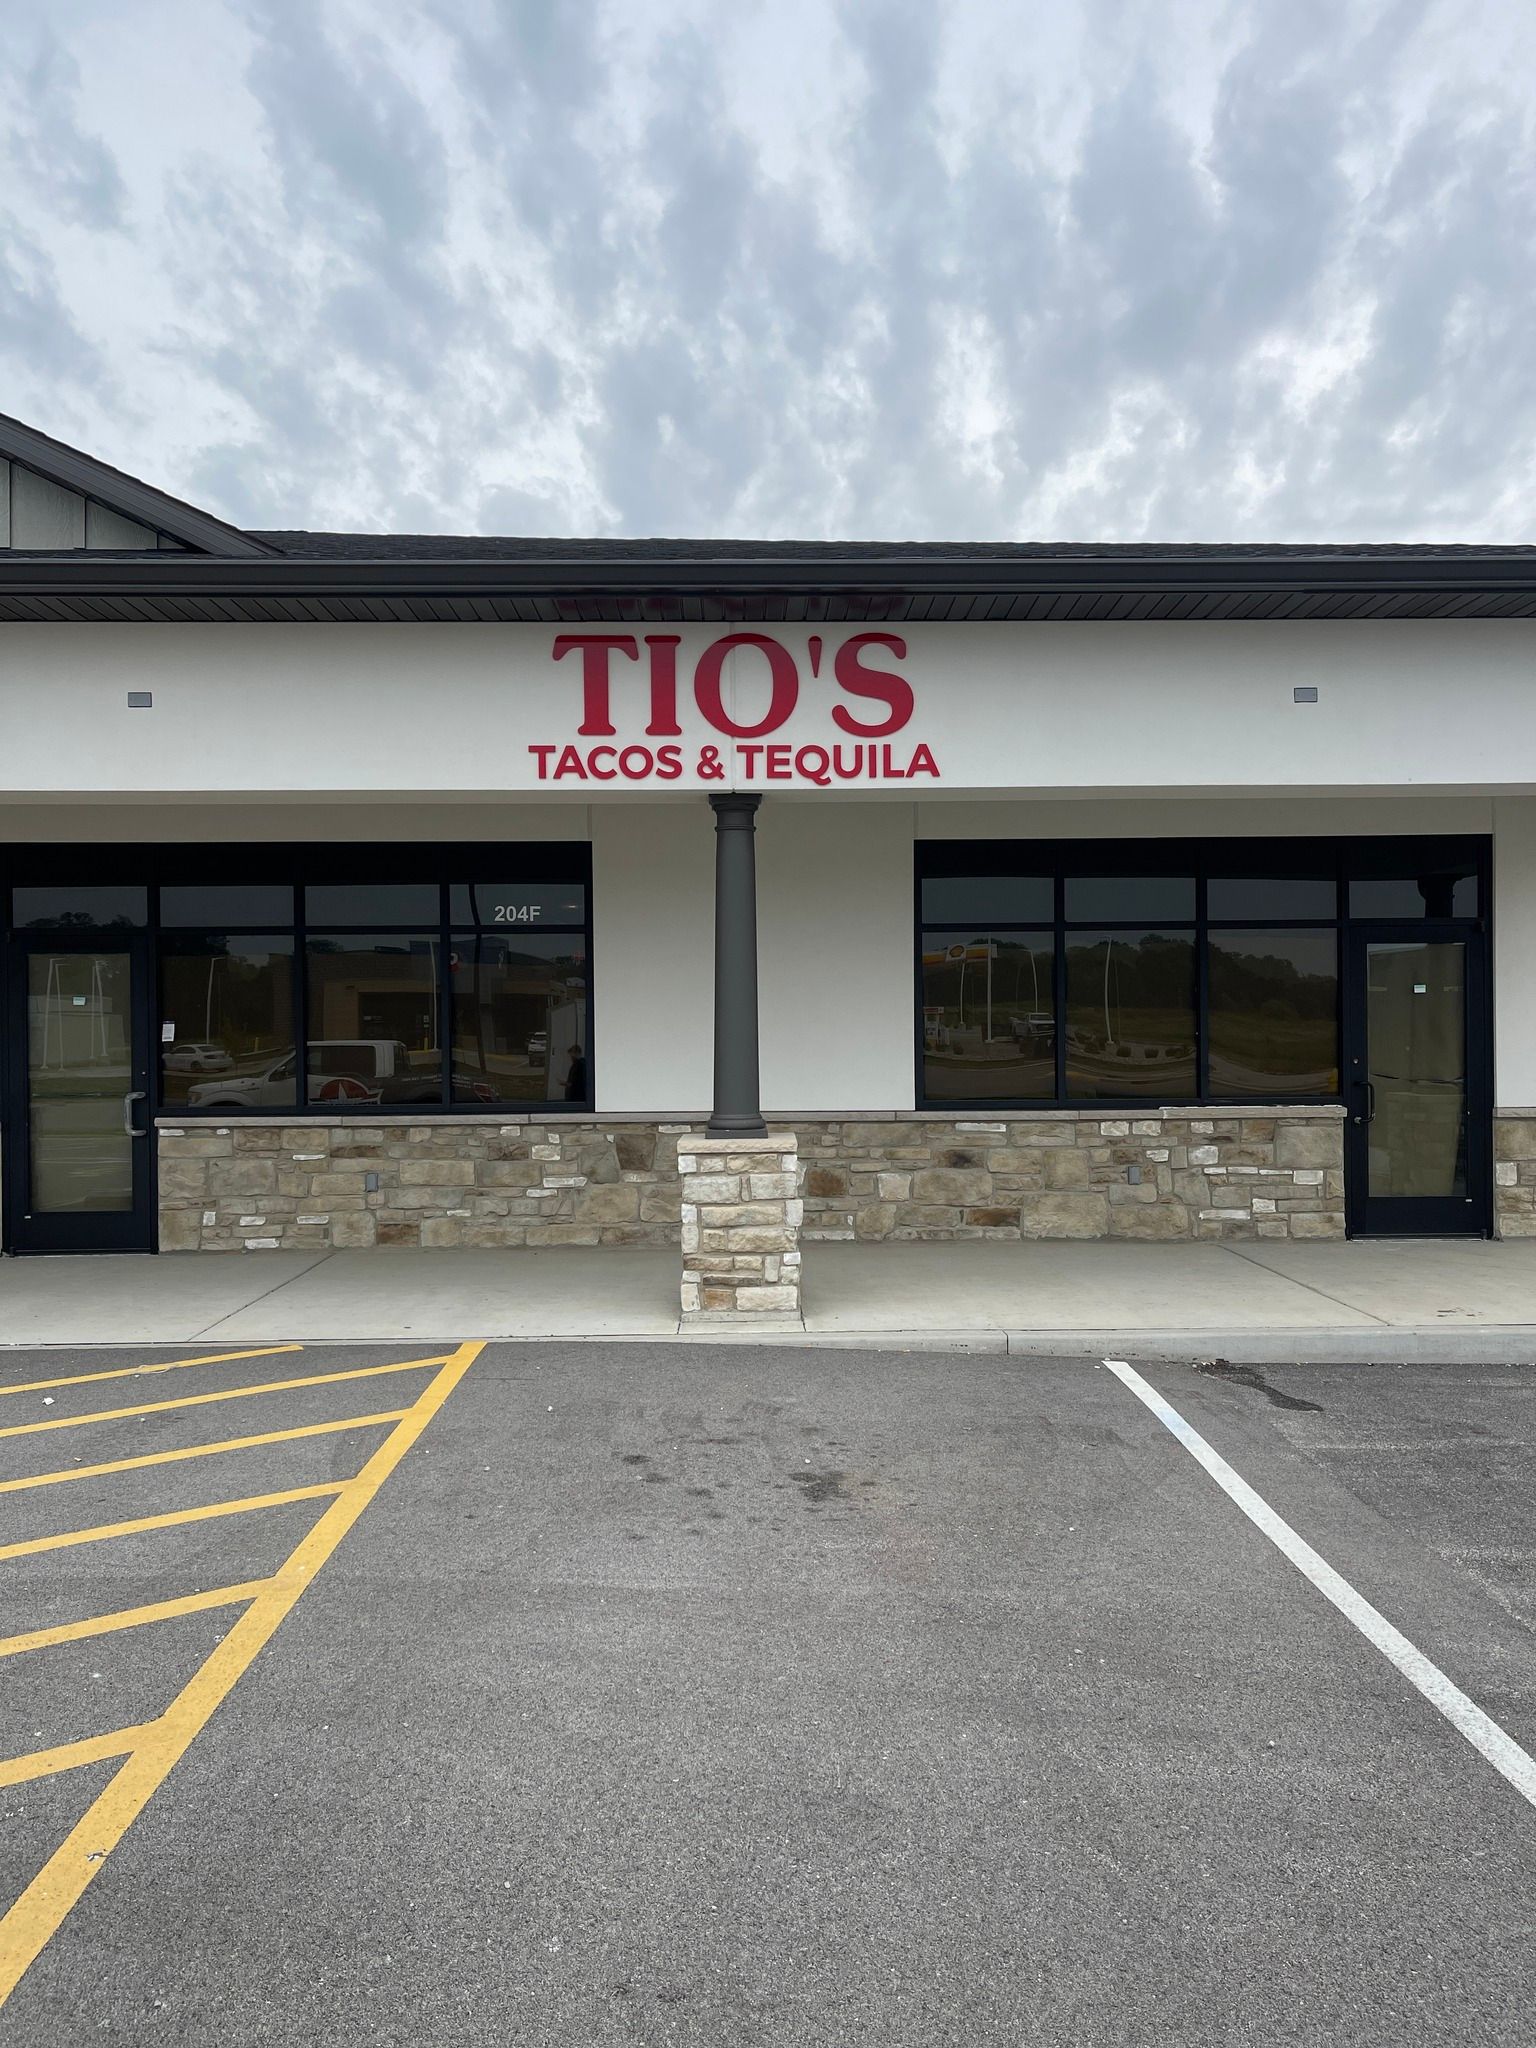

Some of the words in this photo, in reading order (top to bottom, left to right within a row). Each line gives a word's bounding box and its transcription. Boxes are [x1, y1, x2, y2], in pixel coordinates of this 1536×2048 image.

[552, 632, 914, 738] TIO'S
[528, 744, 683, 780] TACOS
[696, 745, 726, 780] &
[736, 743, 940, 786] TEQUILA
[494, 905, 541, 922] 204F
